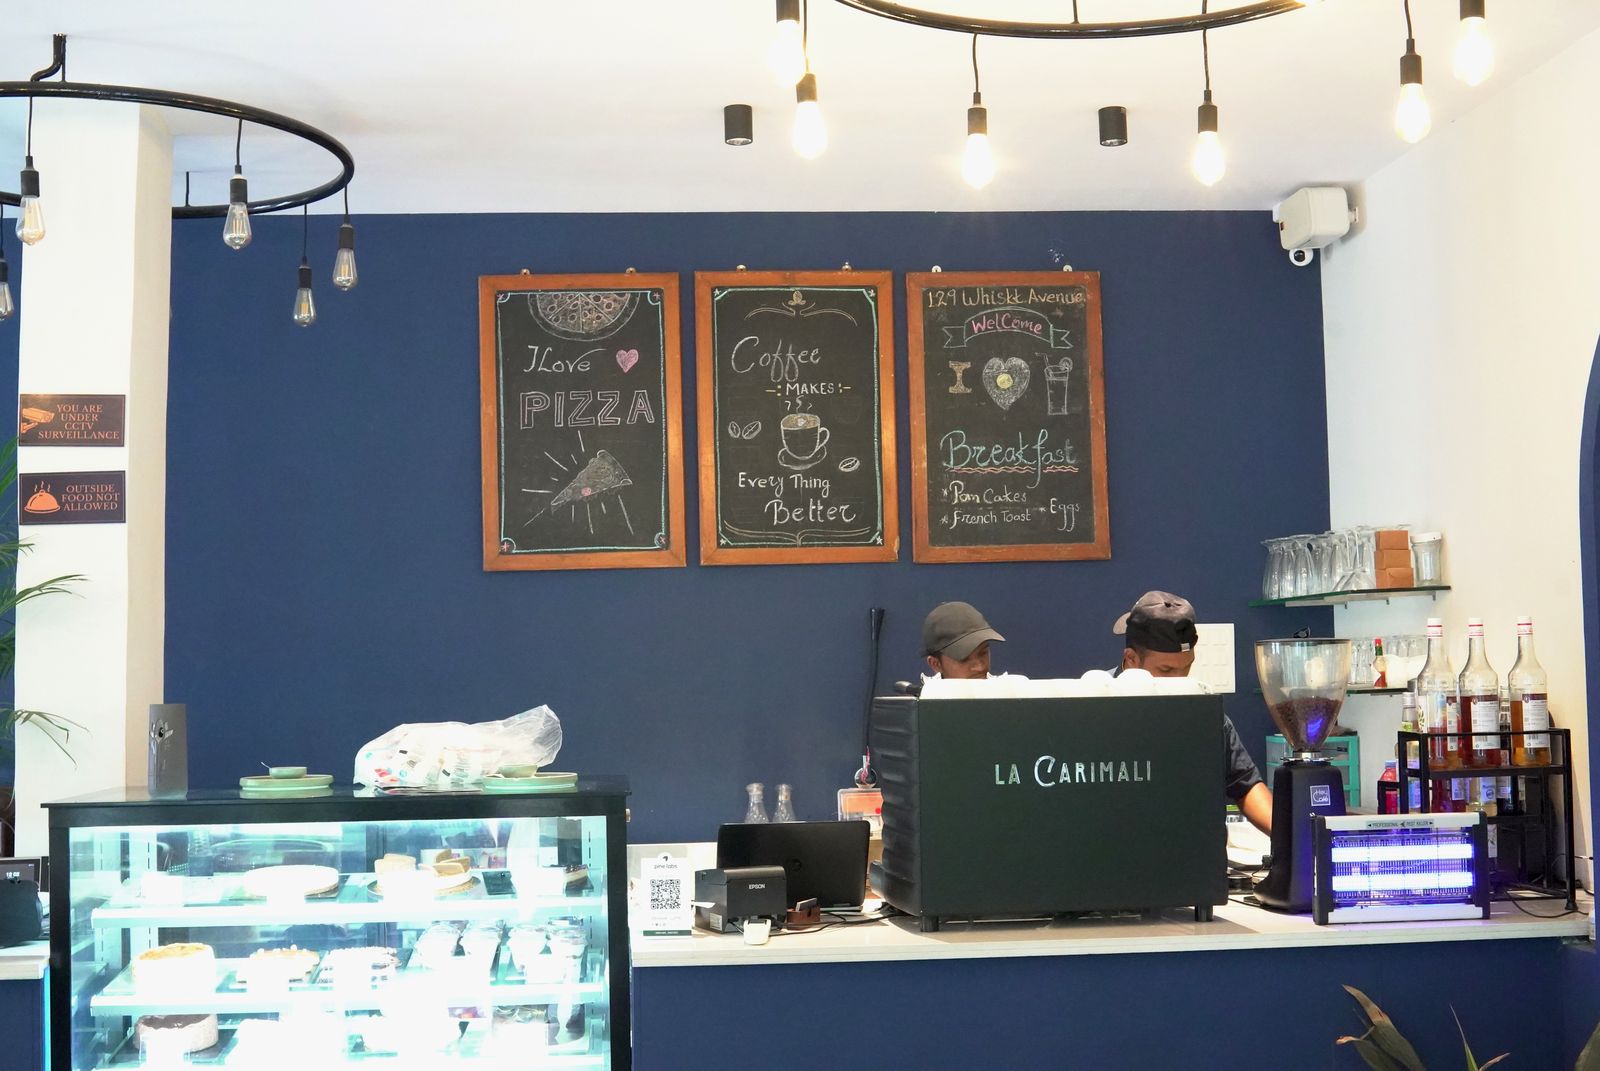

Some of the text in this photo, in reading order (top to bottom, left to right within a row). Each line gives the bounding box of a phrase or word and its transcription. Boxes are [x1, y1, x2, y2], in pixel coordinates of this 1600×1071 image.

[928, 289, 956, 308] 129
[731, 335, 821, 383] Coffee
[949, 361, 973, 394] I
[57, 404, 103, 413] YOU ARE
[60, 413, 99, 422] UNDER
[519, 390, 655, 430] PIZZA
[38, 430, 120, 440] SURVEILLANCE
[64, 422, 94, 430] CCTV
[940, 429, 1076, 489] Breakfast
[66, 484, 115, 493] OUTSIDE
[738, 472, 831, 498] Every Thing
[61, 492, 120, 502] FOOD NOT
[983, 488, 1027, 504] Cakes
[63, 502, 118, 511] ALLOWED
[764, 498, 857, 526] Better
[1050, 498, 1080, 532] Eggs
[950, 510, 1032, 530] French Toast
[995, 755, 1151, 787] LA CARIMALI
